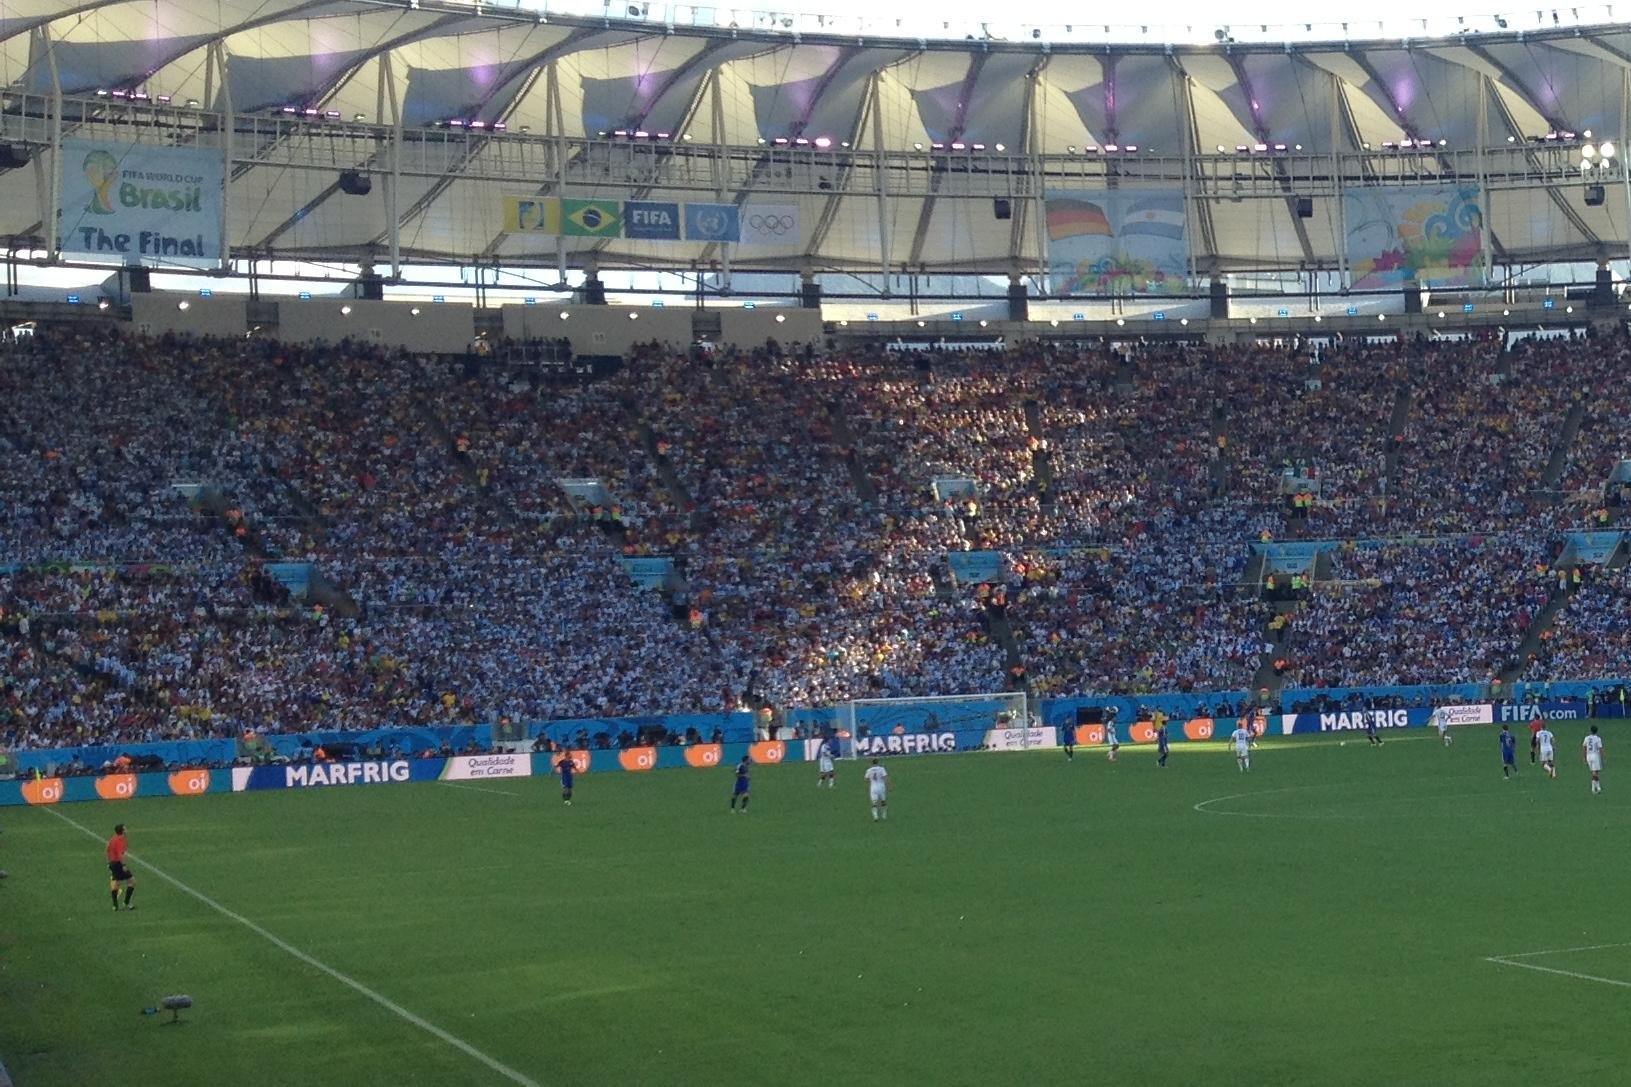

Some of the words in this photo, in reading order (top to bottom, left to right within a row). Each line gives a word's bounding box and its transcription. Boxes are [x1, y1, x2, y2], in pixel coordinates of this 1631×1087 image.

[122, 170, 144, 180] FIFA
[145, 172, 183, 183] WORLD
[184, 175, 203, 185] CUP
[119, 182, 202, 212] Brasil
[633, 210, 672, 225] FIFA
[79, 226, 131, 252] The
[139, 231, 205, 257] Final
[1089, 726, 1103, 741] oi
[1198, 721, 1212, 736] oi
[854, 732, 956, 755] MARFRIG
[638, 750, 653, 767] oi
[703, 747, 719, 763] oi
[766, 745, 783, 760] oi
[468, 756, 514, 768] Qualidade
[286, 760, 410, 787] MARFRIG
[487, 766, 514, 776] Carne
[42, 781, 60, 799] oi
[115, 776, 133, 796] oi
[188, 772, 206, 792] oi
